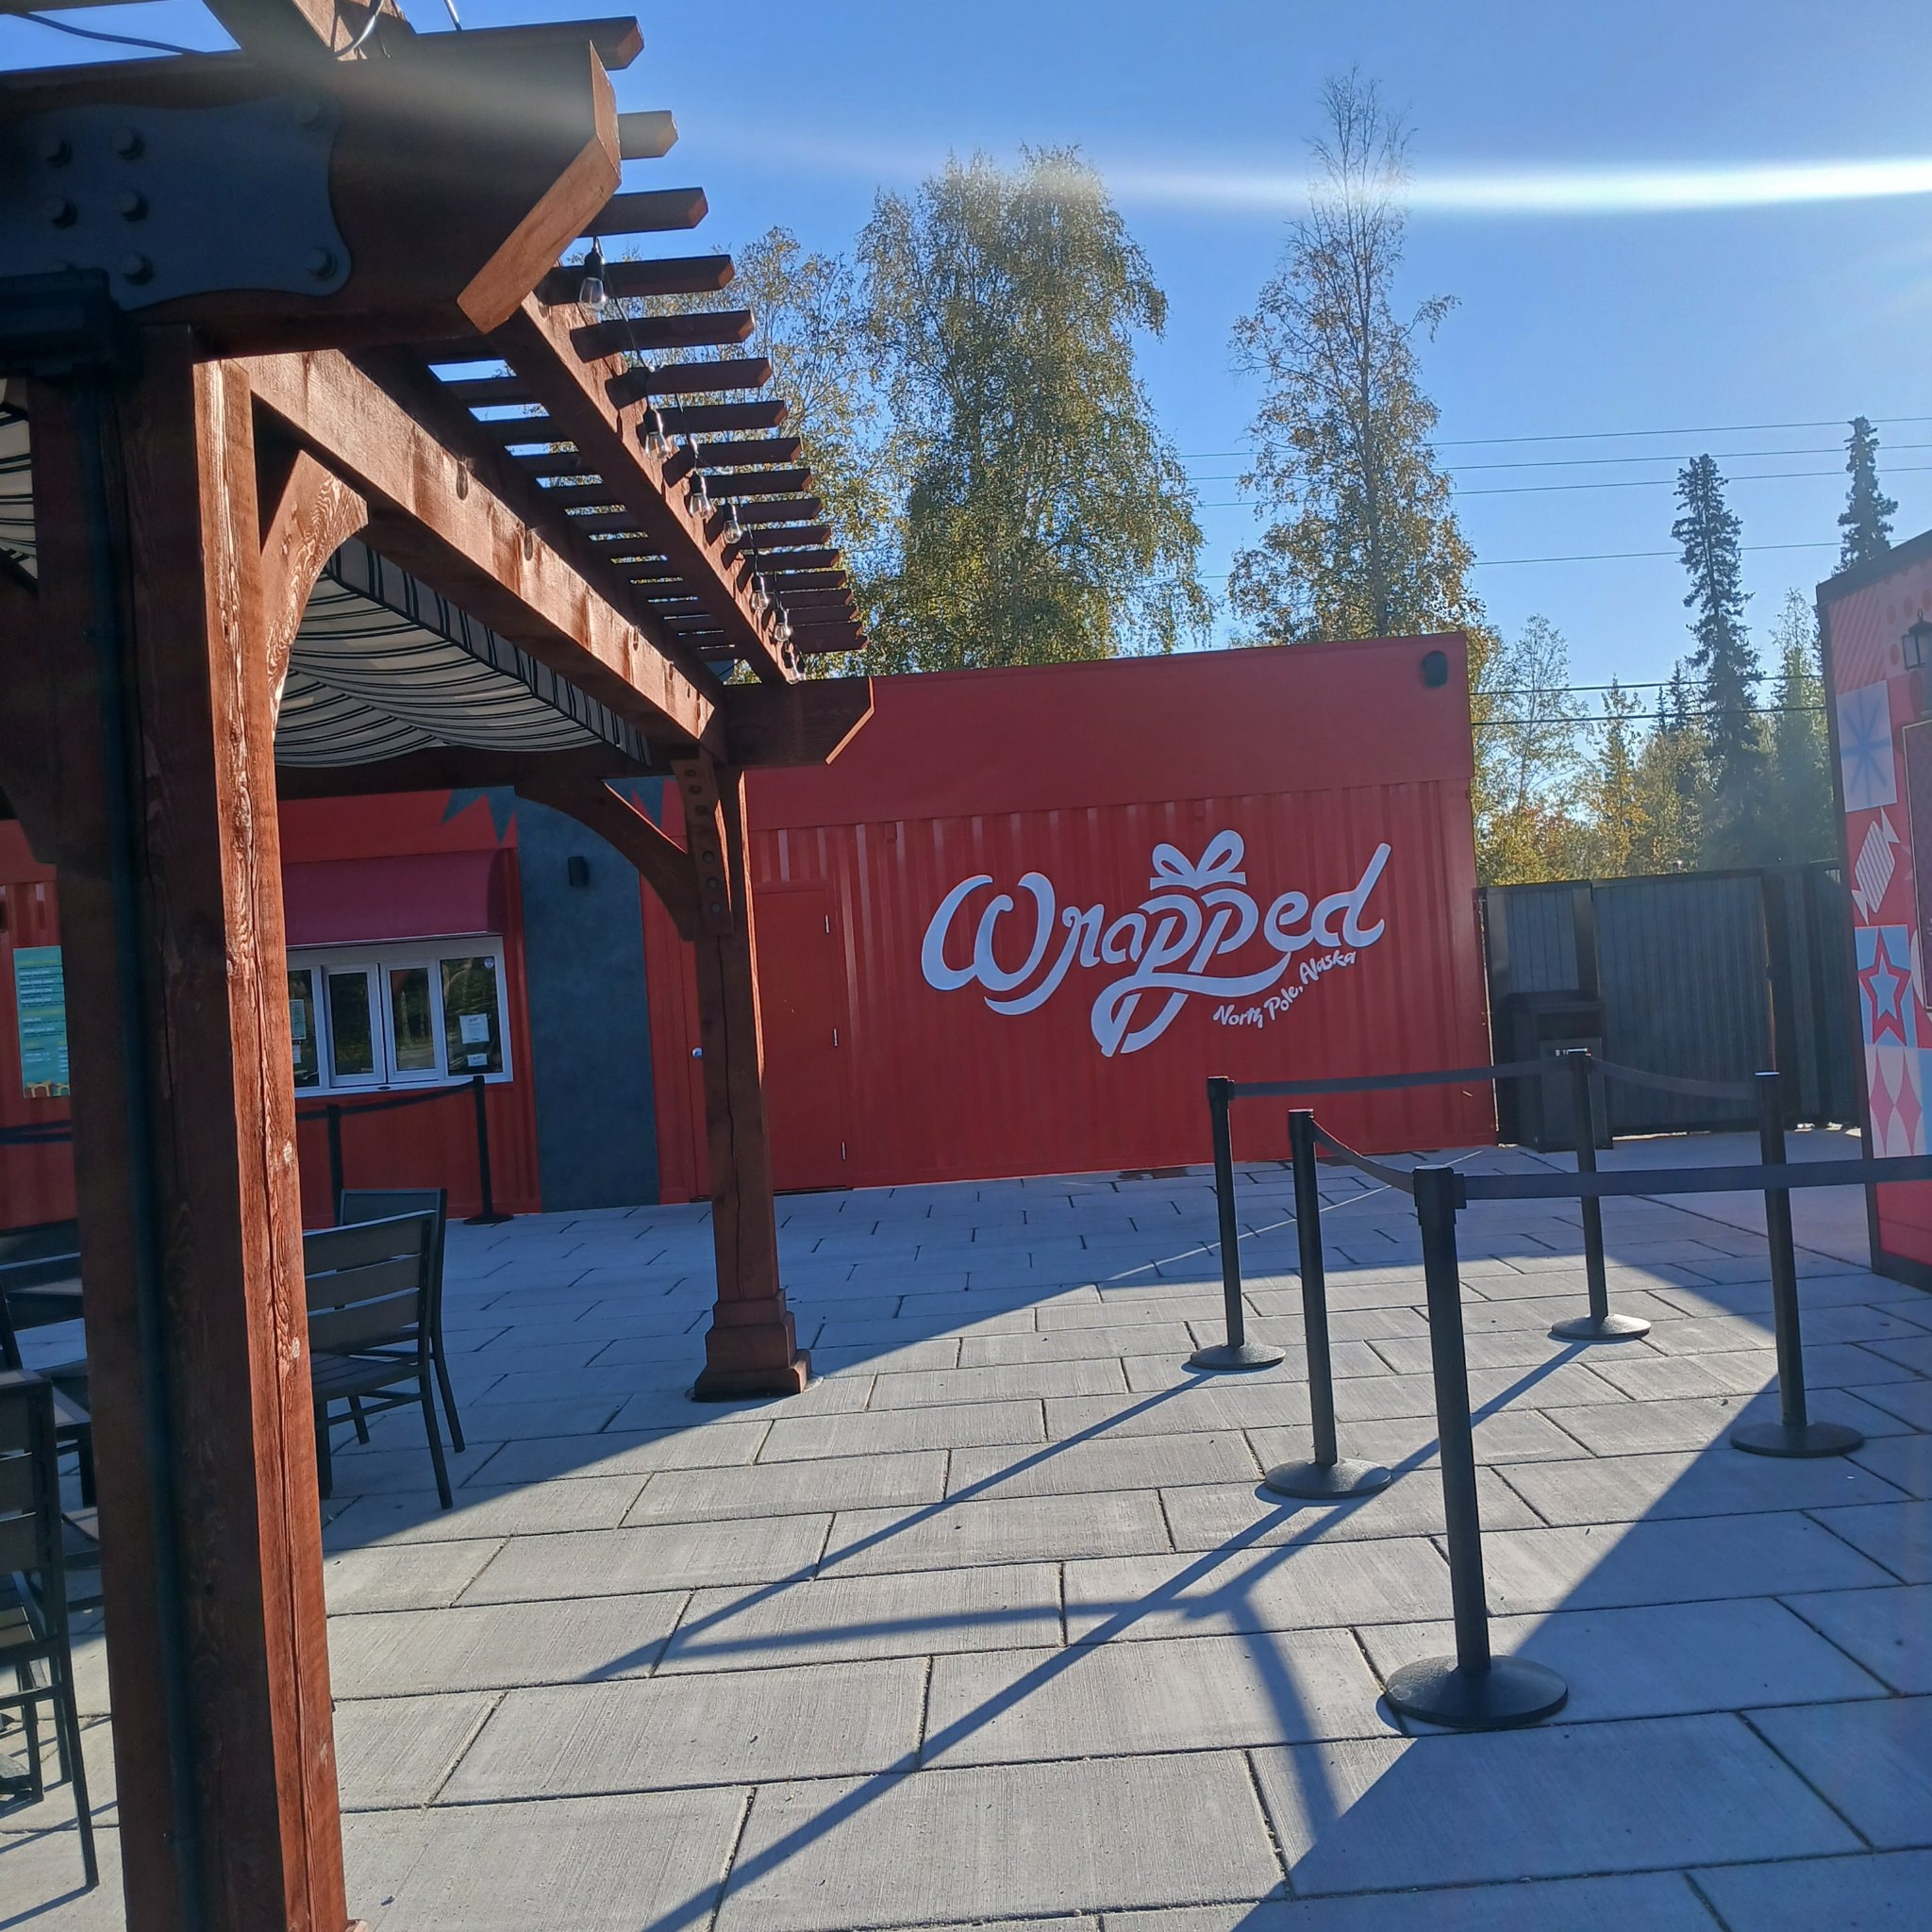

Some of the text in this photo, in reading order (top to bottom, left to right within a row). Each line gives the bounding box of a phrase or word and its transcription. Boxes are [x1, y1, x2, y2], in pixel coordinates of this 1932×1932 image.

[921, 841, 1391, 1058] Wrapped
[1212, 949, 1357, 1029] North Pole, Alaska
